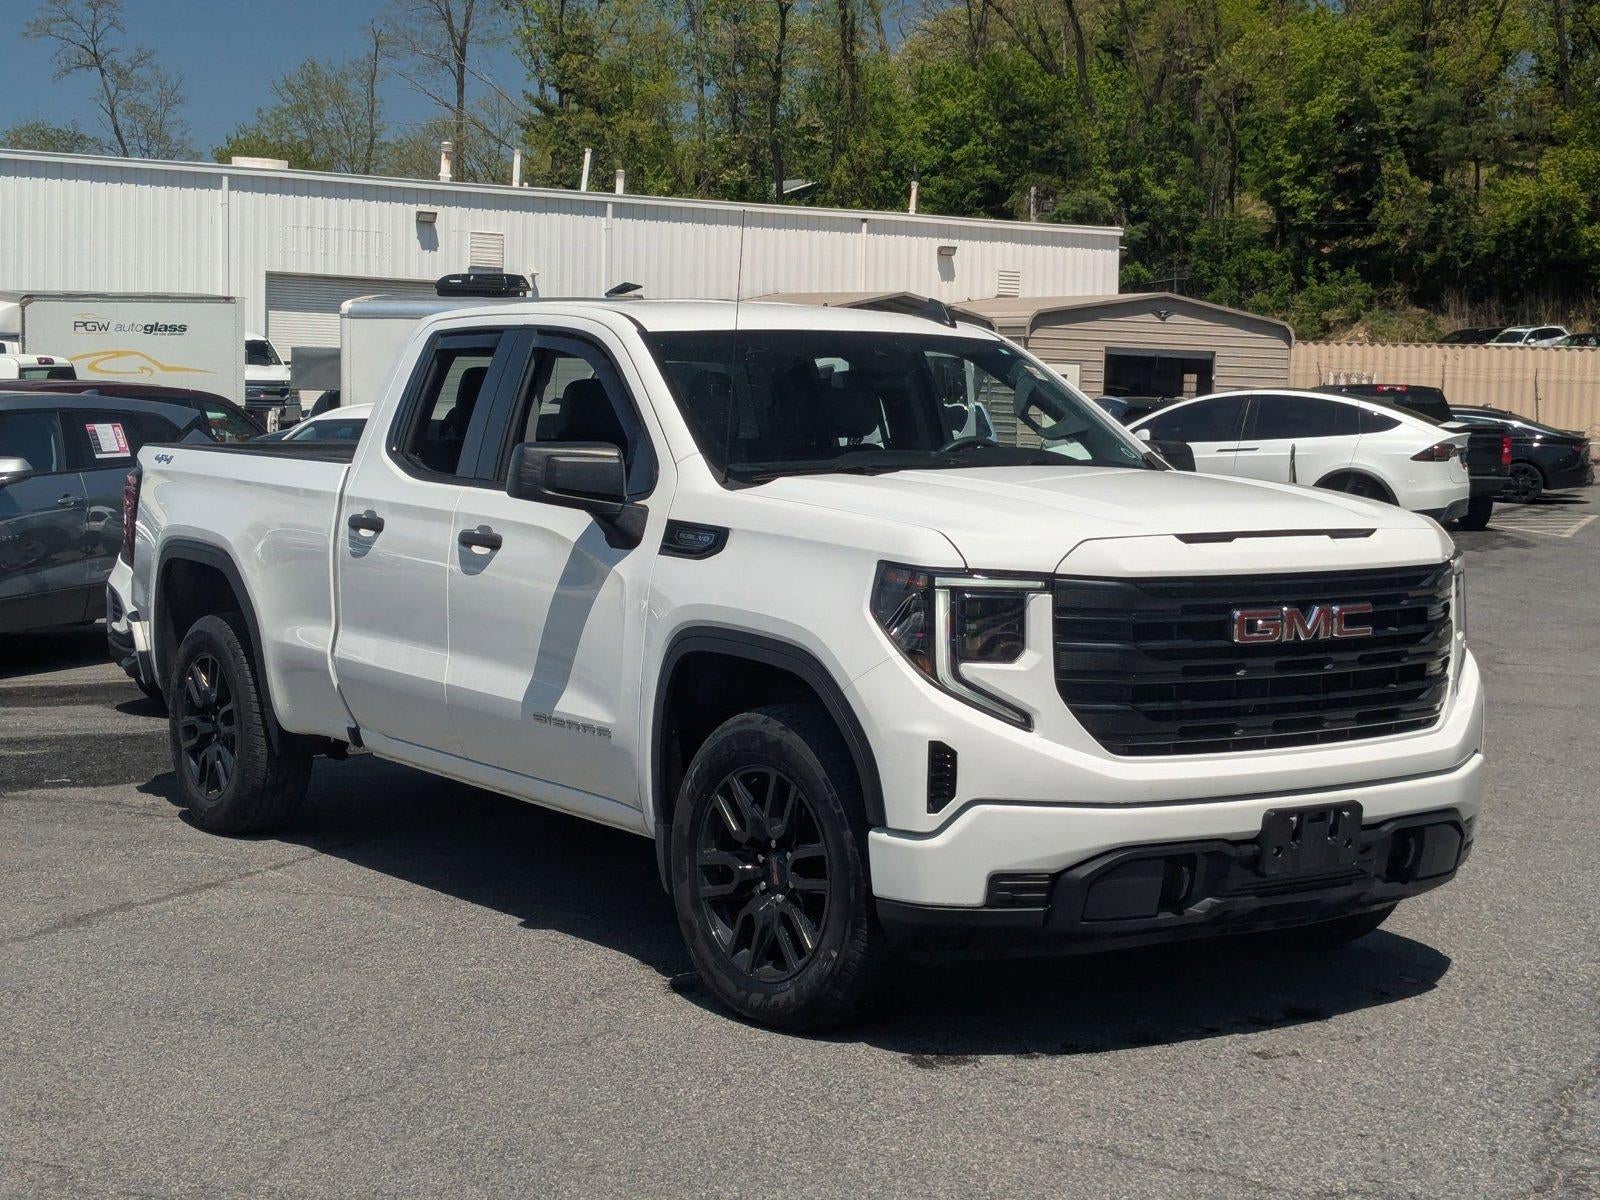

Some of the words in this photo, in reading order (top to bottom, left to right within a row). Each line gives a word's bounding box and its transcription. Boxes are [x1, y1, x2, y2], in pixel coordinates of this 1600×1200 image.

[73, 321, 111, 332] PGW
[114, 321, 188, 335] autoglass
[1232, 601, 1373, 644] GMC
[532, 711, 612, 739] SIERRA
